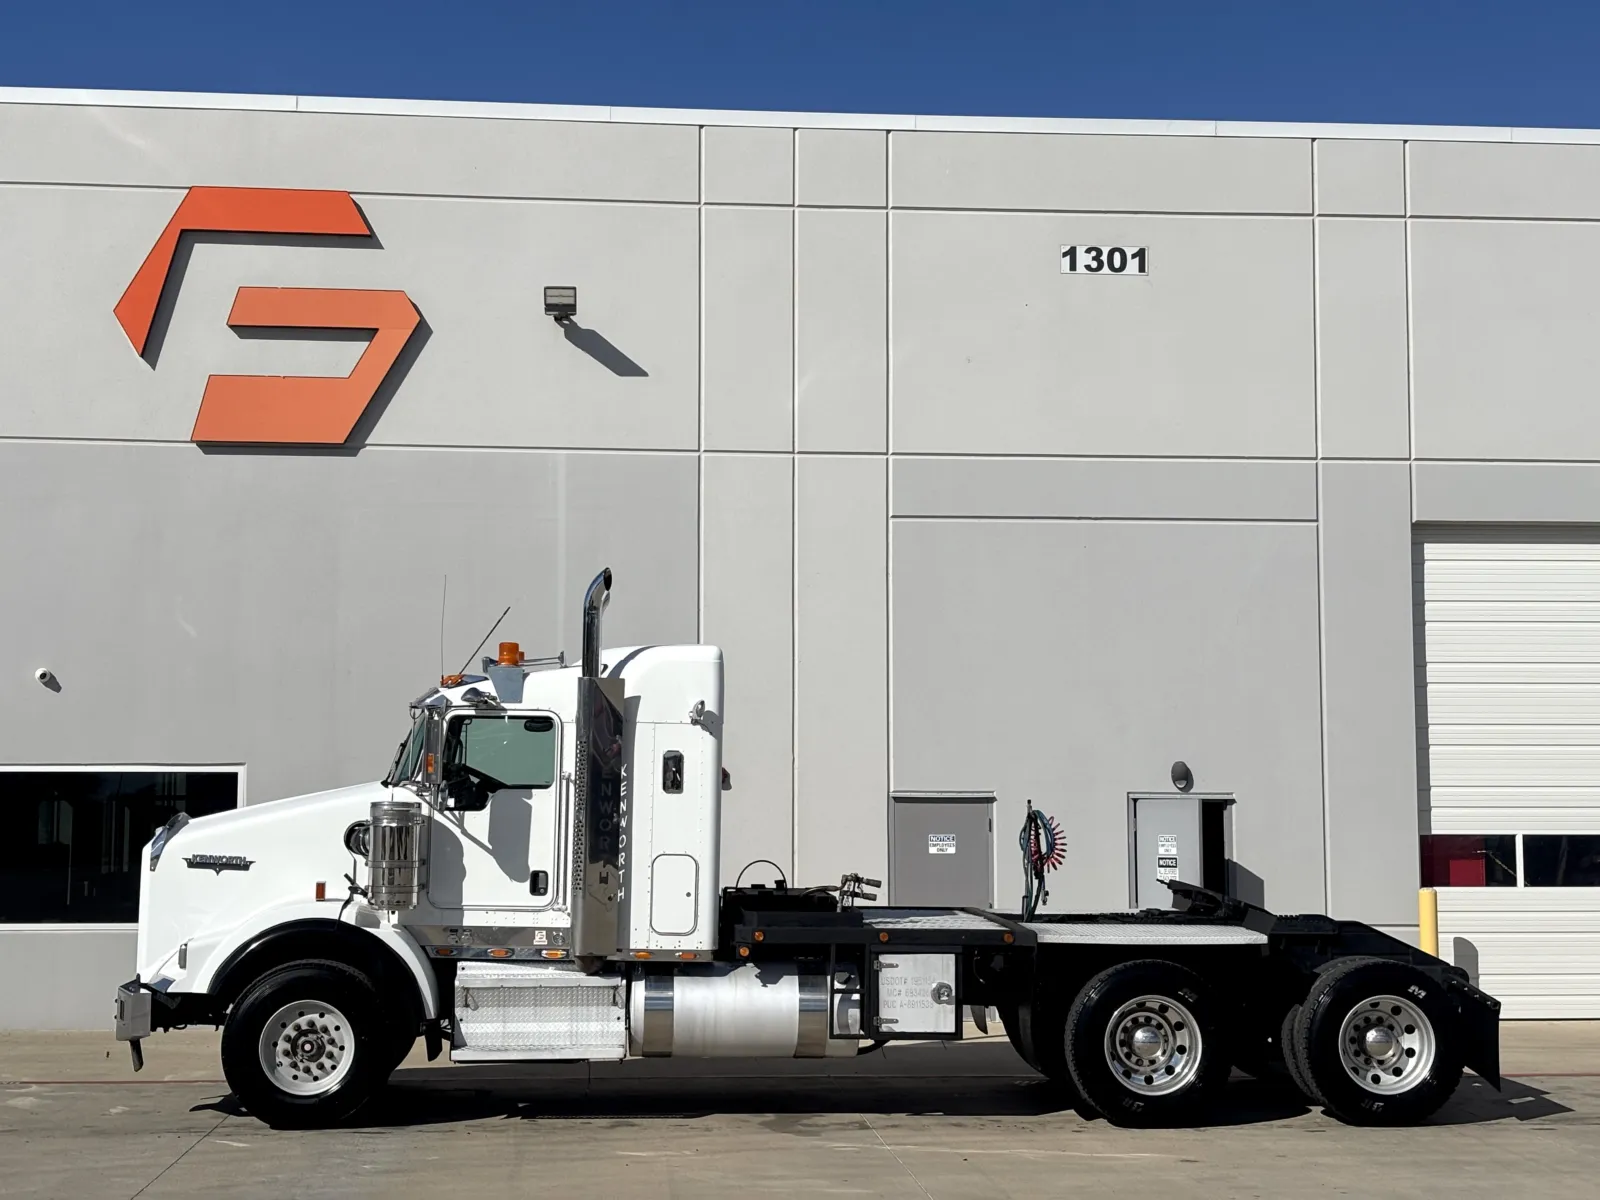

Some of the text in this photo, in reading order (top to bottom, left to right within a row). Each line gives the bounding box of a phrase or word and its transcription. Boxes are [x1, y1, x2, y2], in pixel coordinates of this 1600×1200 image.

[1062, 246, 1146, 273] 1301
[617, 763, 628, 902] KENWORTH
[191, 854, 247, 865] KENWORTH
[1159, 859, 1177, 867] NOTICE
[880, 976, 908, 986] USDOT#
[887, 988, 902, 997] MC#
[883, 1000, 897, 1009] PUC
